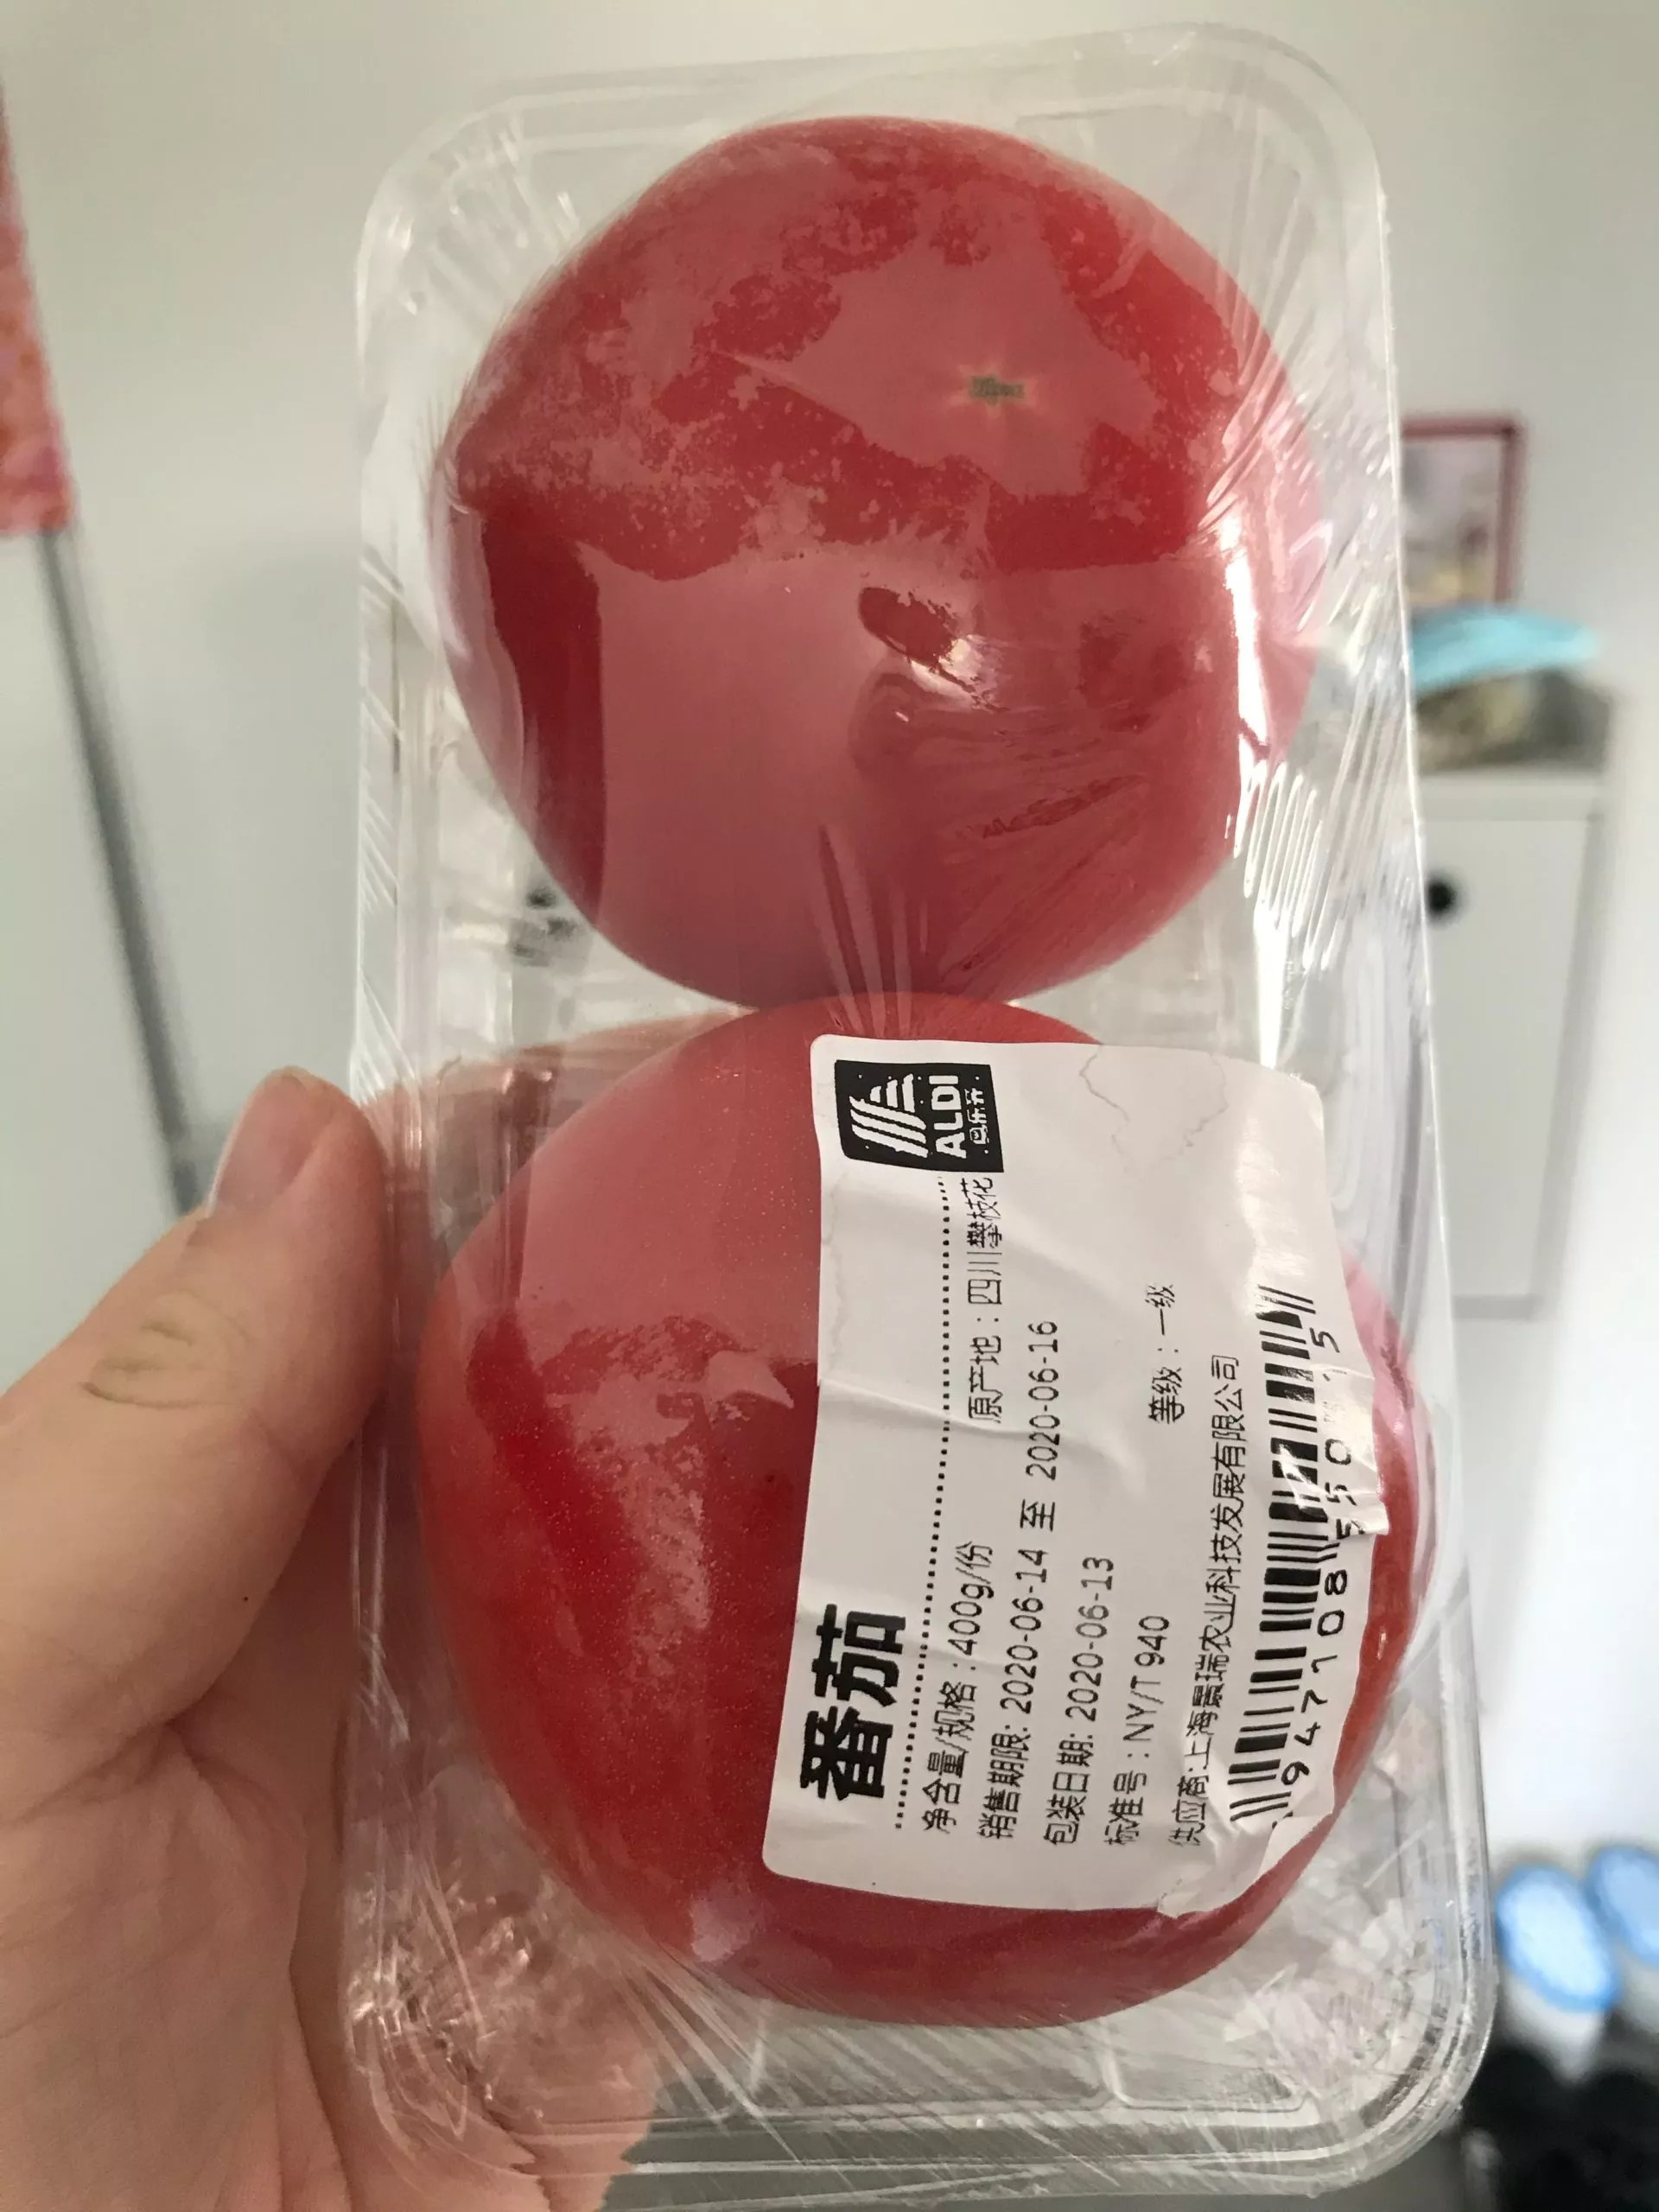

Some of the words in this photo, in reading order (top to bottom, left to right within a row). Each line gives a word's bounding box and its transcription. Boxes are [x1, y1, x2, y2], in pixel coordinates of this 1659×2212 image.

[929, 1075, 967, 1159] ALDI
[1026, 1322, 1060, 1480] 2020-06-16
[1020, 1499, 1055, 1532] 至
[802, 1604, 906, 1801] 番茄
[1000, 1549, 1047, 1714] 2020-06-14
[1065, 1557, 1114, 1722] 2020-06-13
